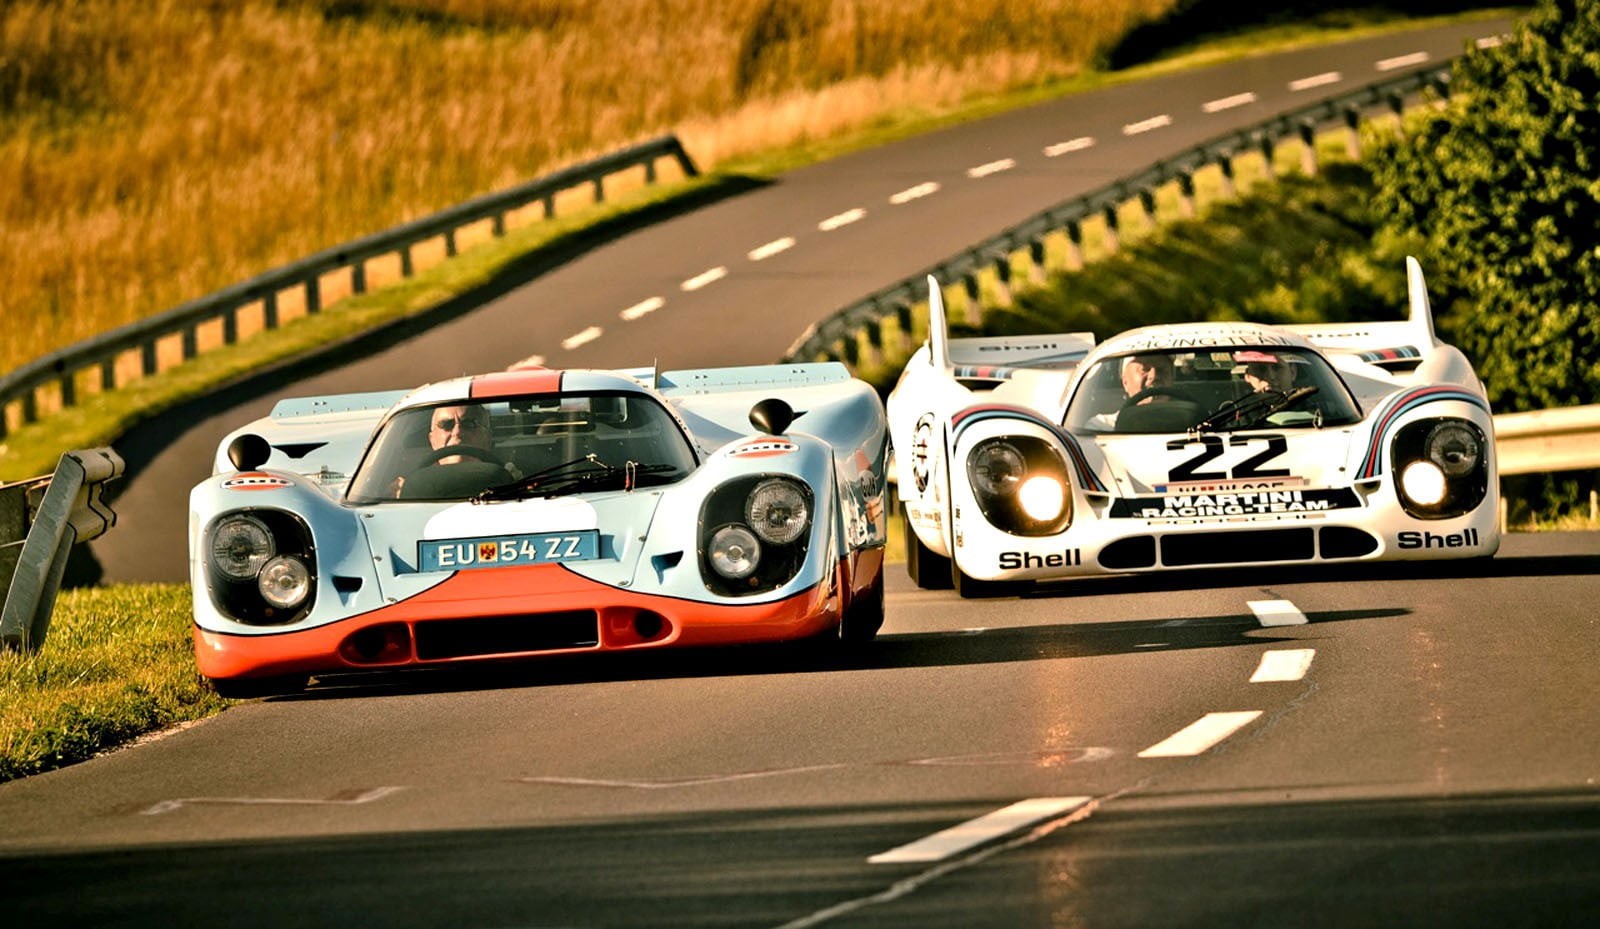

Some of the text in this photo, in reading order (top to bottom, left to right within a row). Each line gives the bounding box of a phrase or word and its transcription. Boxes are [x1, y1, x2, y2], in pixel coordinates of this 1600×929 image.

[1166, 434, 1291, 482] 22
[1142, 501, 1330, 519] RACING-TEAM
[1163, 490, 1302, 510] MARTINI
[1397, 528, 1478, 549] Shell
[438, 536, 581, 566] EU 54 ZZ
[999, 548, 1081, 570] Shell
